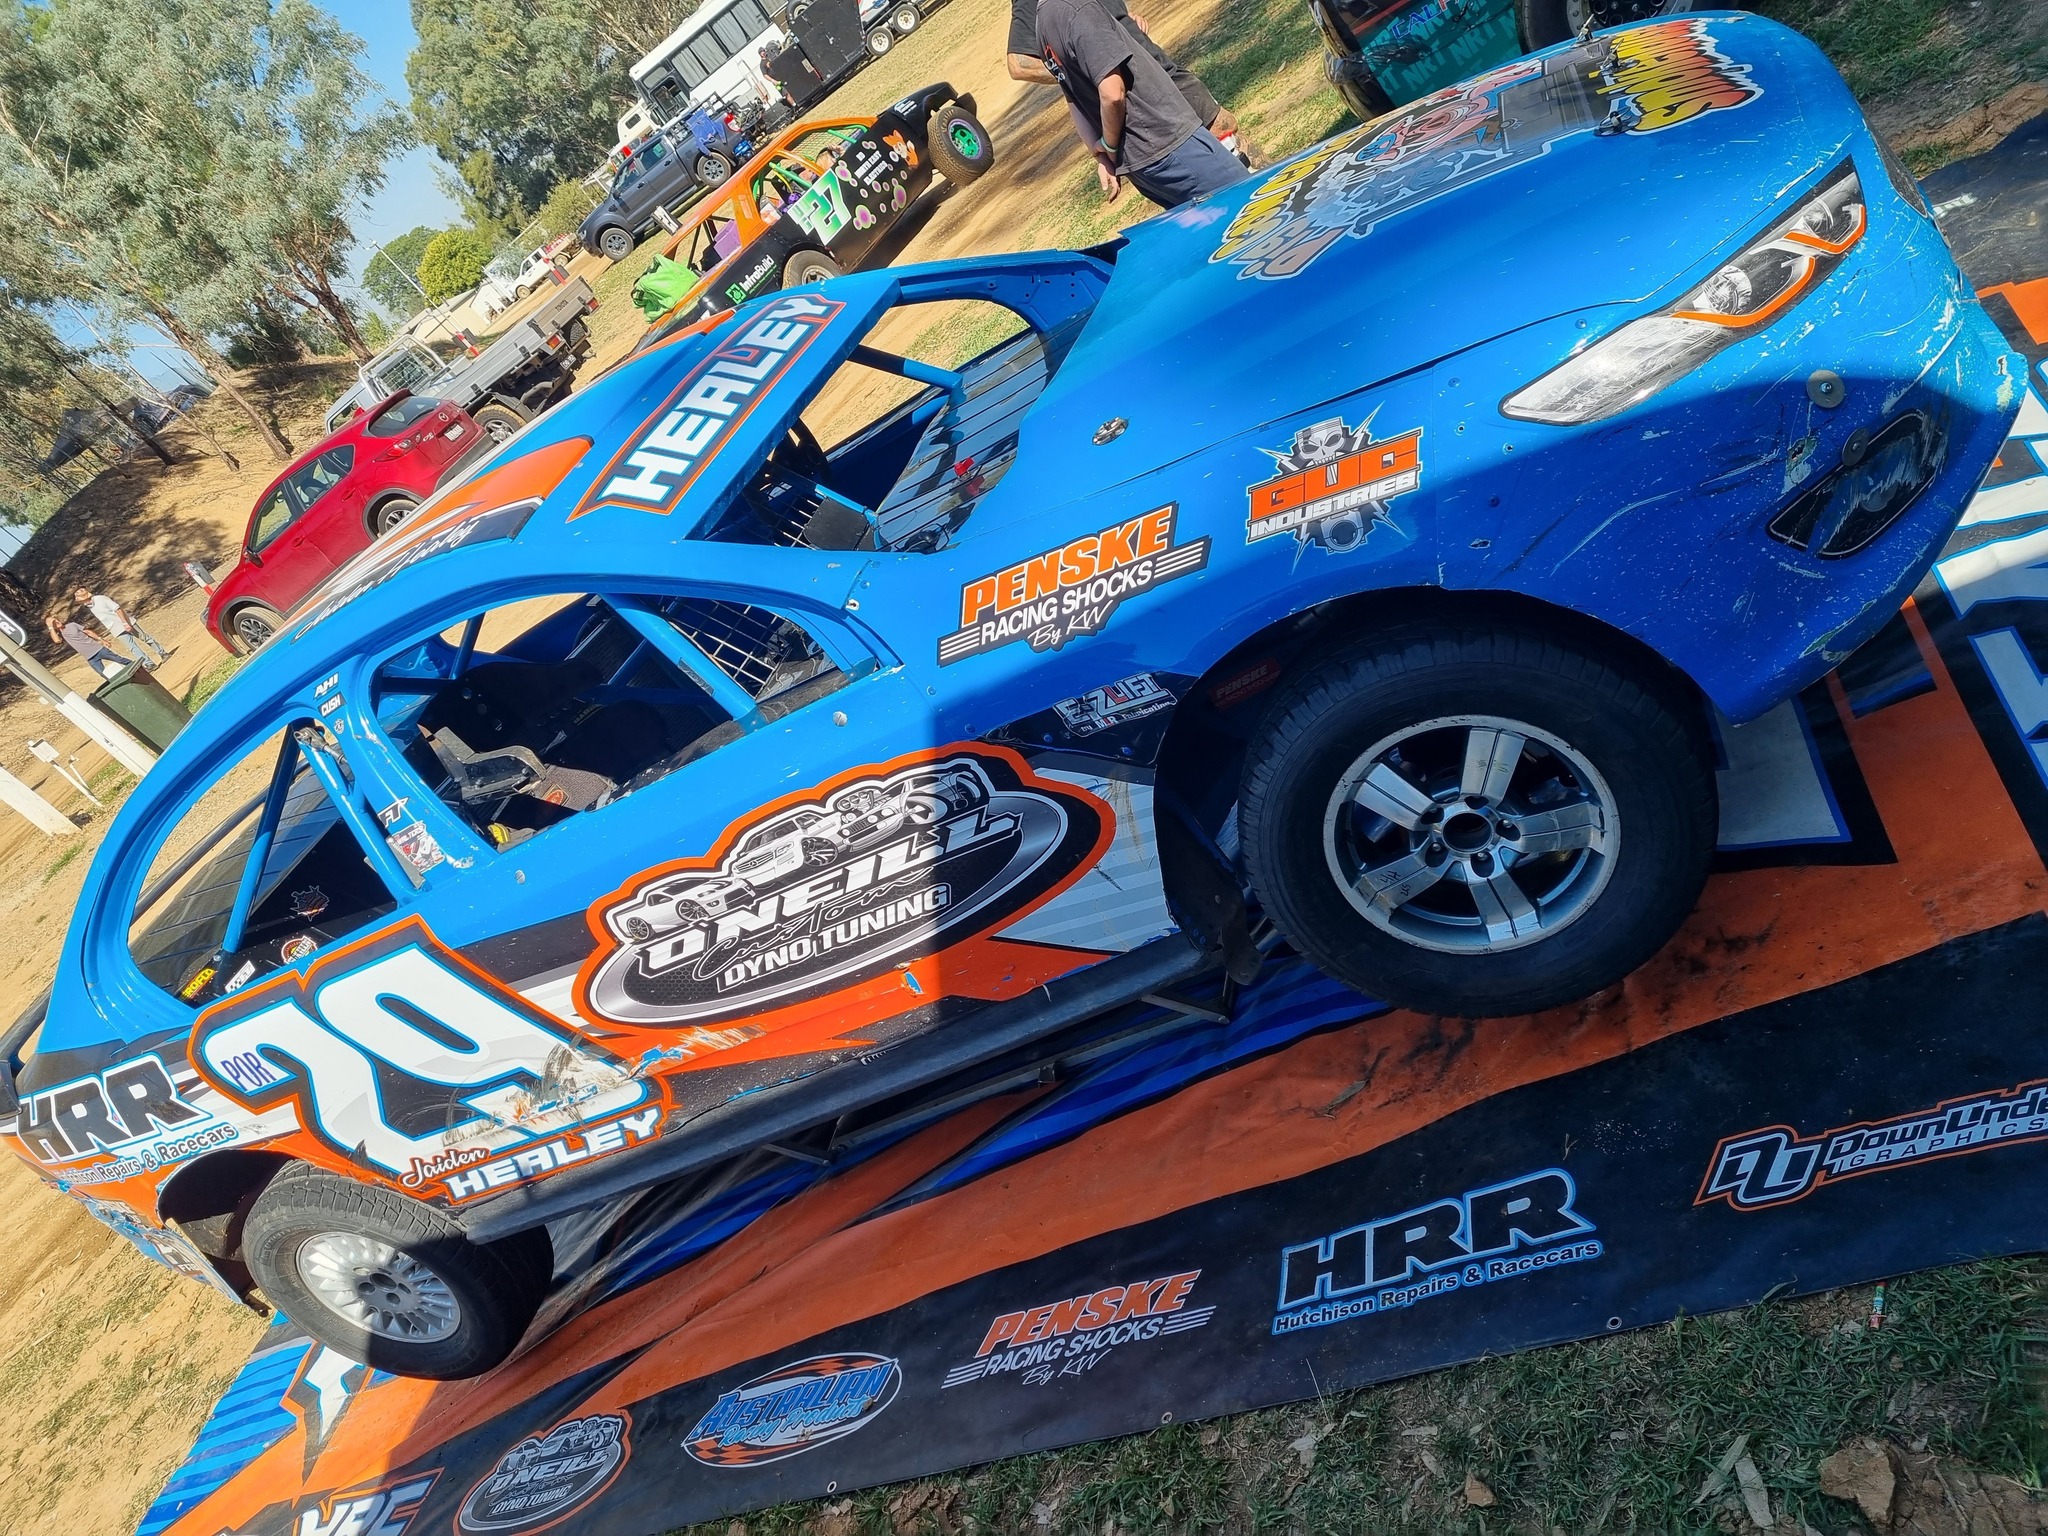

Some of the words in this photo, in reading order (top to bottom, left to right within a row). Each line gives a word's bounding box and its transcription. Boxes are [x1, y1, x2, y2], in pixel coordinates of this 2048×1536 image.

[809, 168, 851, 246] 27
[739, 254, 775, 292] InfraBuild
[597, 298, 830, 503] HEALEY
[1249, 471, 1417, 538] INDUSTRIES
[962, 504, 1173, 628] PENSKE
[980, 602, 1057, 646] RACING
[1062, 561, 1153, 614] SHOCKS
[1029, 625, 1062, 648] By
[1216, 664, 1268, 700] PENSKE
[724, 938, 813, 989] DYNO
[820, 884, 950, 955] TUNING
[203, 945, 648, 1176] 29
[221, 1051, 276, 1091] POR
[18, 1060, 201, 1161] HRR
[1851, 1117, 2044, 1167] GRAPHICS
[98, 1158, 141, 1182] Repairs
[144, 1151, 157, 1168] &
[158, 1124, 237, 1161] Racecars
[402, 1148, 487, 1187] Jaiden
[444, 1108, 660, 1199] HEALEY
[1279, 1170, 1595, 1307] HRR
[974, 1269, 1203, 1358] PENSKE
[1275, 1298, 1374, 1332] Hutchison
[1380, 1276, 1458, 1307] Repairs
[1465, 1266, 1482, 1283] &
[1489, 1243, 1599, 1277] Racecars
[981, 1341, 1066, 1377] RACING
[1064, 1318, 1163, 1357] SHOCKS
[1022, 1364, 1054, 1386] By
[688, 1363, 896, 1440] AUSTRALIAN
[718, 1418, 781, 1448] Racing
[780, 1396, 871, 1431] Products
[493, 1496, 527, 1515] DYNO
[526, 1484, 573, 1508] TUNING
